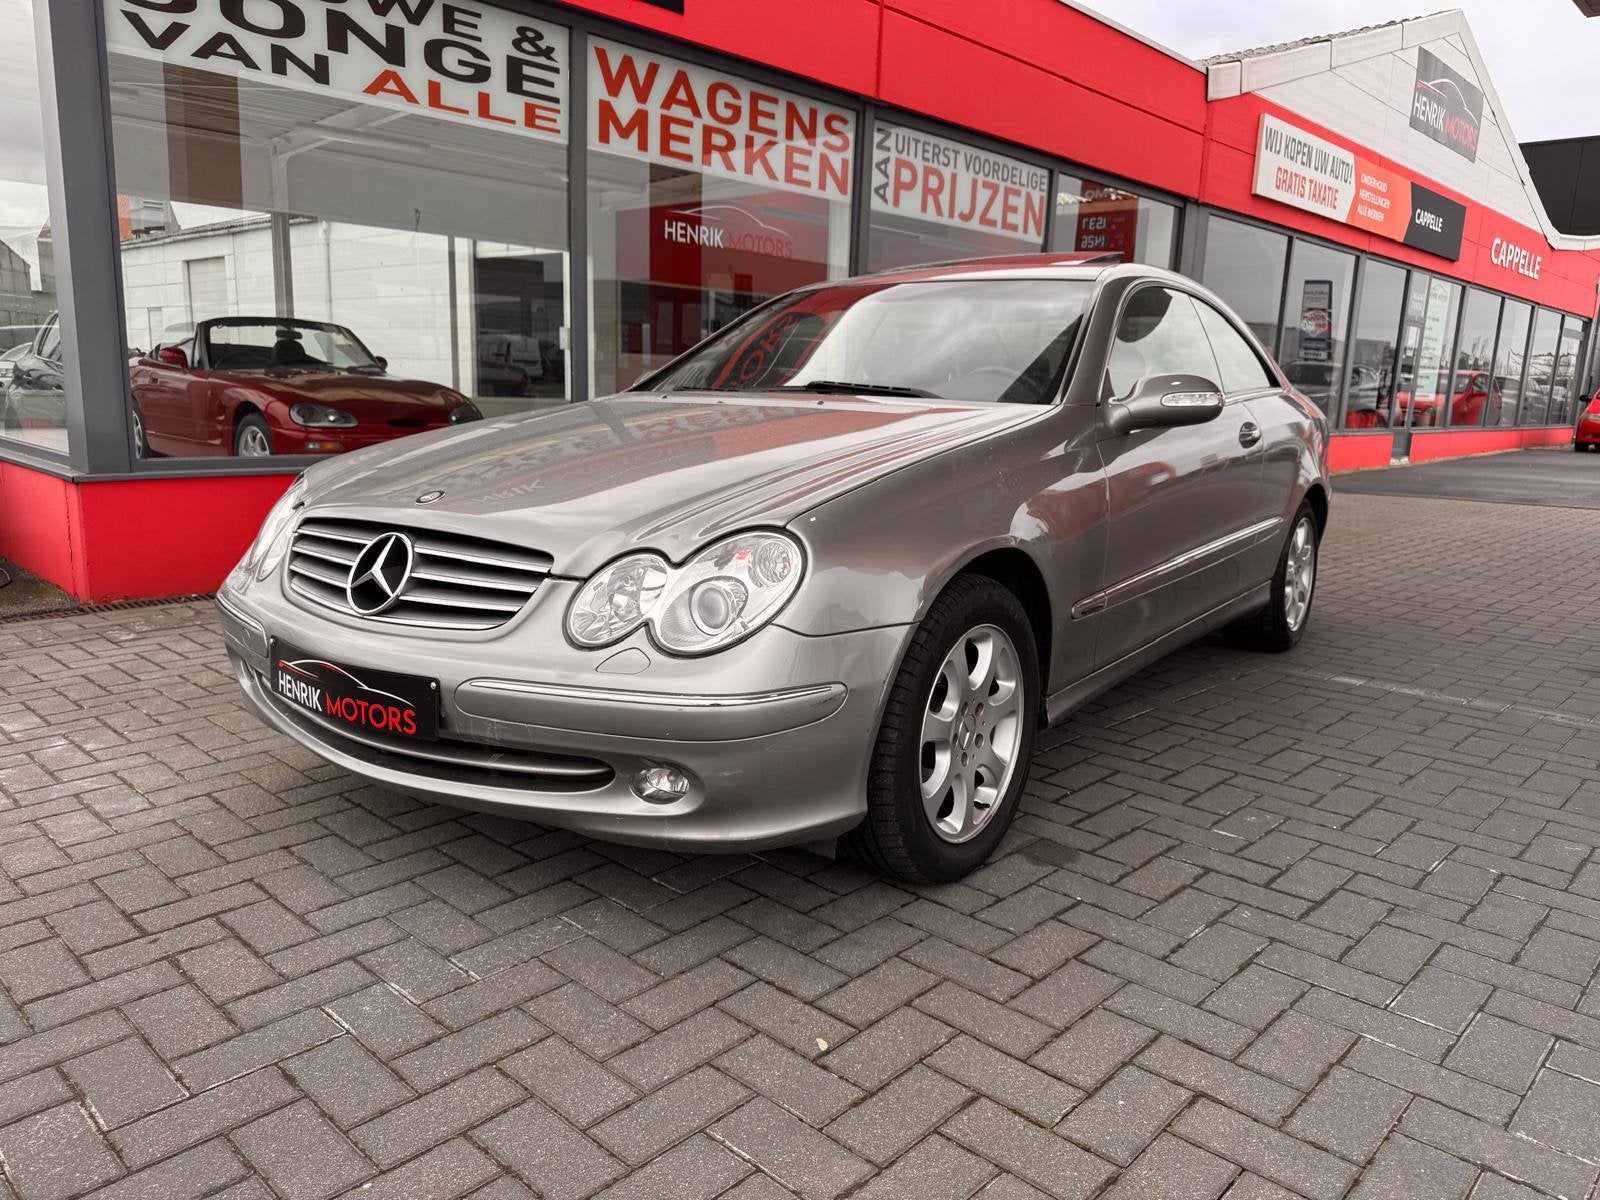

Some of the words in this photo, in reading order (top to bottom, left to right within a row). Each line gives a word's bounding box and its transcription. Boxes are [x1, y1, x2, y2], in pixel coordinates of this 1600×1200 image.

[120, 9, 330, 86] VAN
[362, 69, 561, 135] ALLE
[122, 0, 561, 104] ONGE
[511, 25, 559, 63] &
[594, 46, 850, 154] WAGENS
[1412, 91, 1447, 132] HENRIK
[1444, 115, 1479, 152] MOTORS
[598, 98, 850, 196] MERKEN
[874, 127, 892, 206] AAN
[895, 132, 960, 170] UITERST
[964, 151, 1047, 193] VOORDELIGE
[1264, 126, 1284, 156] WIJ
[1283, 134, 1314, 169] KOPEN
[1314, 147, 1331, 176] UW
[1329, 155, 1354, 186] AUTO!
[892, 156, 1046, 238] PRIJZEN
[1275, 166, 1307, 199] GRATIS
[1308, 178, 1339, 210] TAXATIE
[664, 219, 724, 249] HENRIK
[727, 230, 793, 259] MOTORS
[1415, 208, 1443, 233] CAPPELLE
[1490, 236, 1542, 280] CAPPELLE
[278, 670, 322, 713] HENRIK
[325, 692, 417, 736] MOTORS
